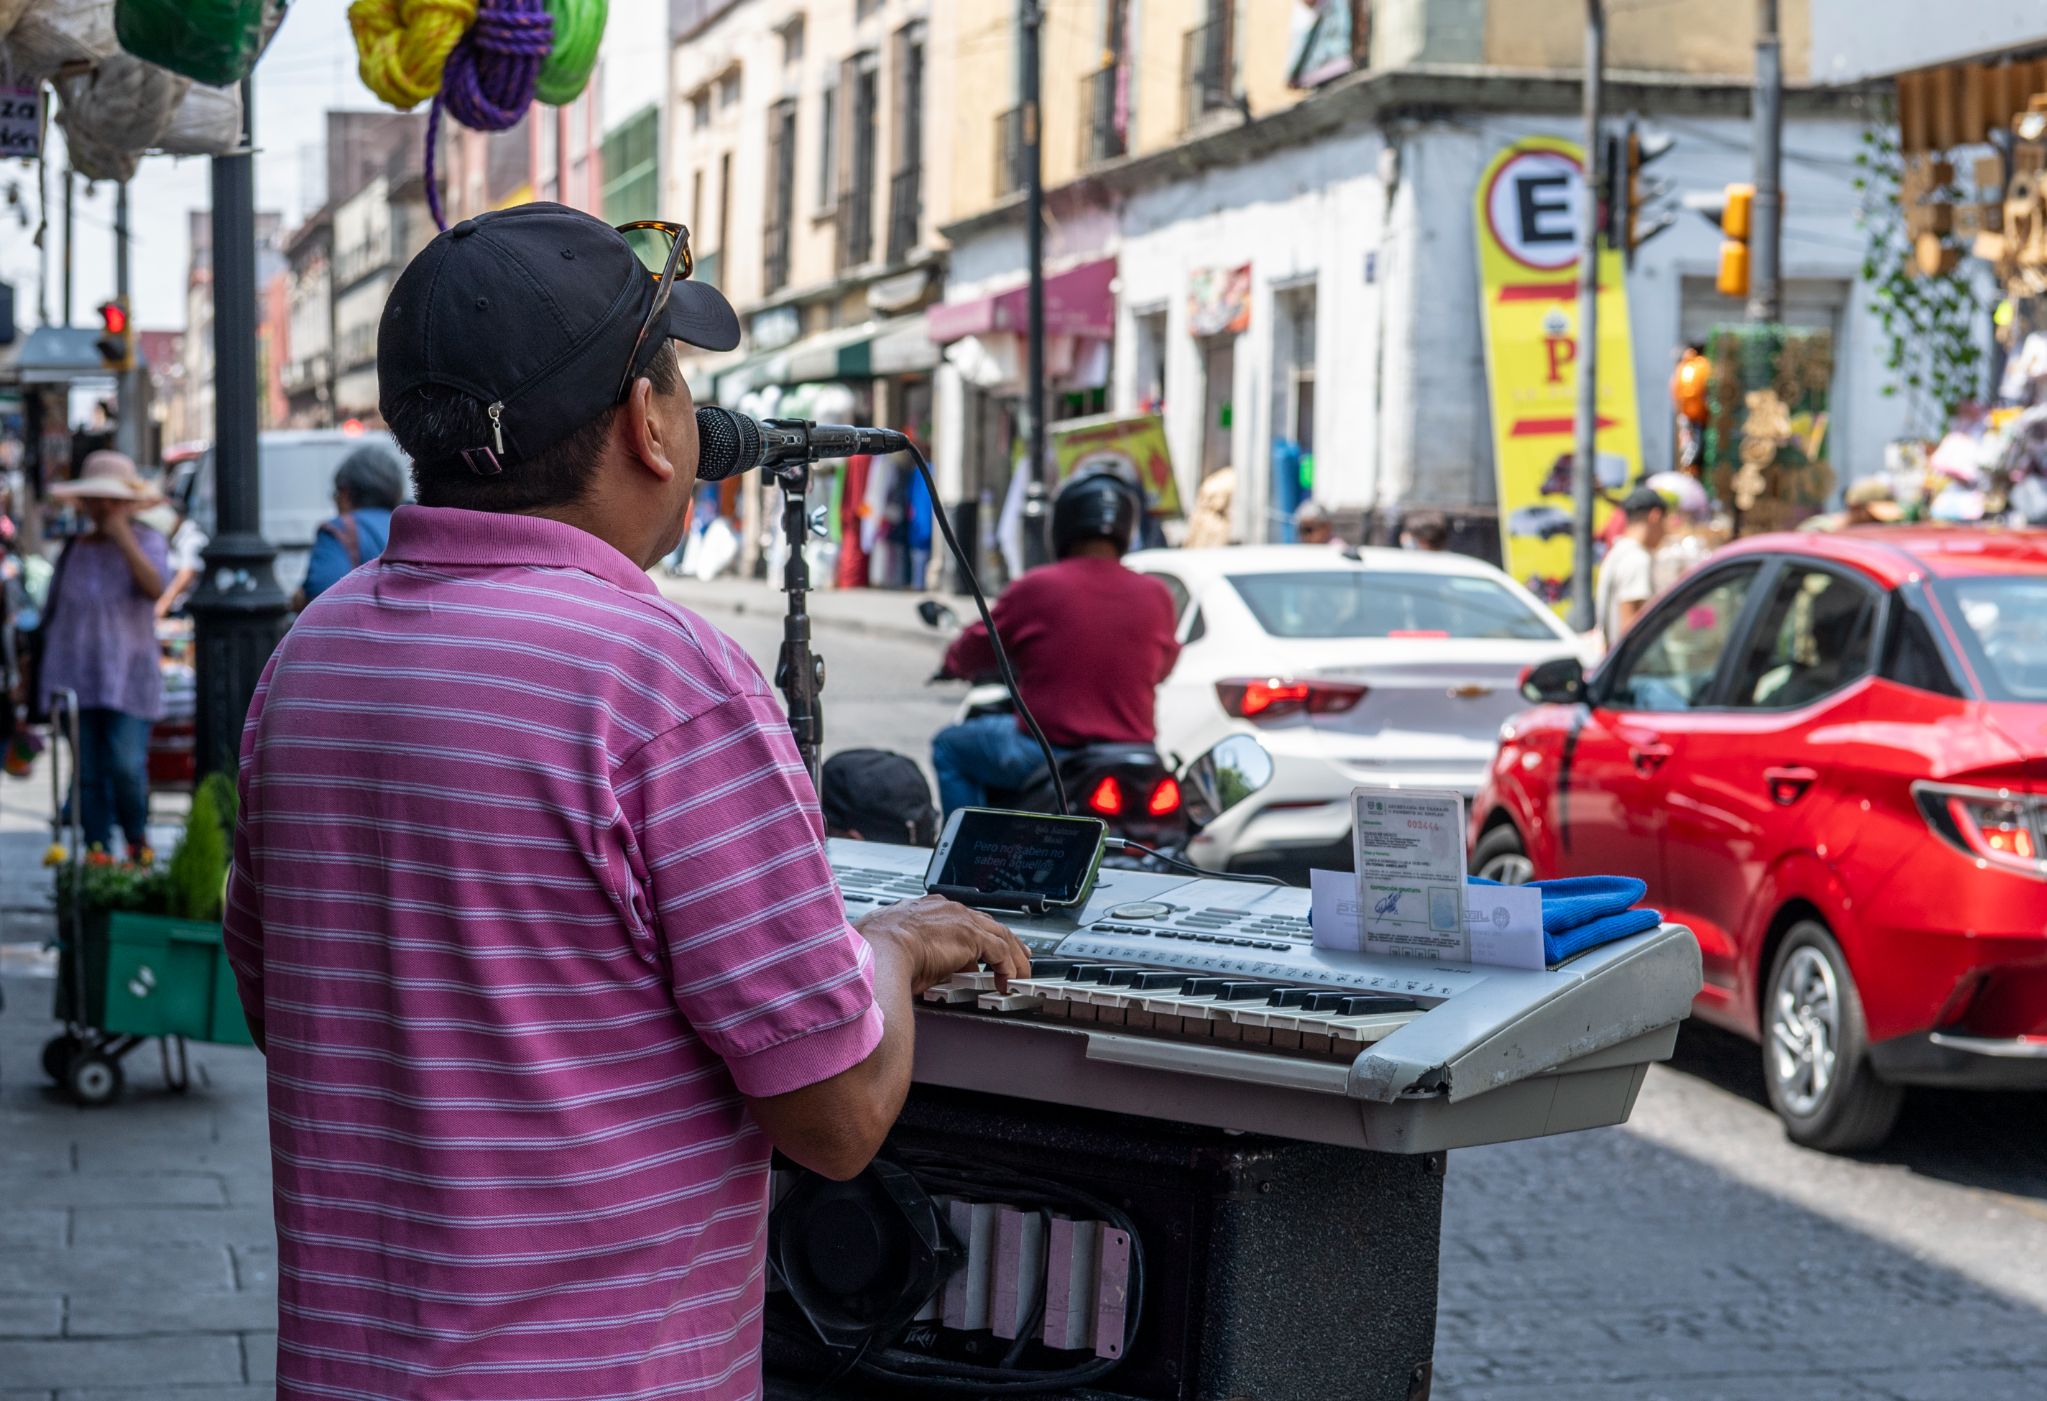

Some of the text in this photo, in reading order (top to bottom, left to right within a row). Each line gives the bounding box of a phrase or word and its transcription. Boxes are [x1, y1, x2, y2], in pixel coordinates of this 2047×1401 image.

[1517, 176, 1574, 243] E
[1544, 336, 1577, 383] P
[974, 855, 1007, 866] saben
[975, 840, 998, 852] Pero
[1000, 845, 1013, 853] no
[1051, 848, 1064, 858] no
